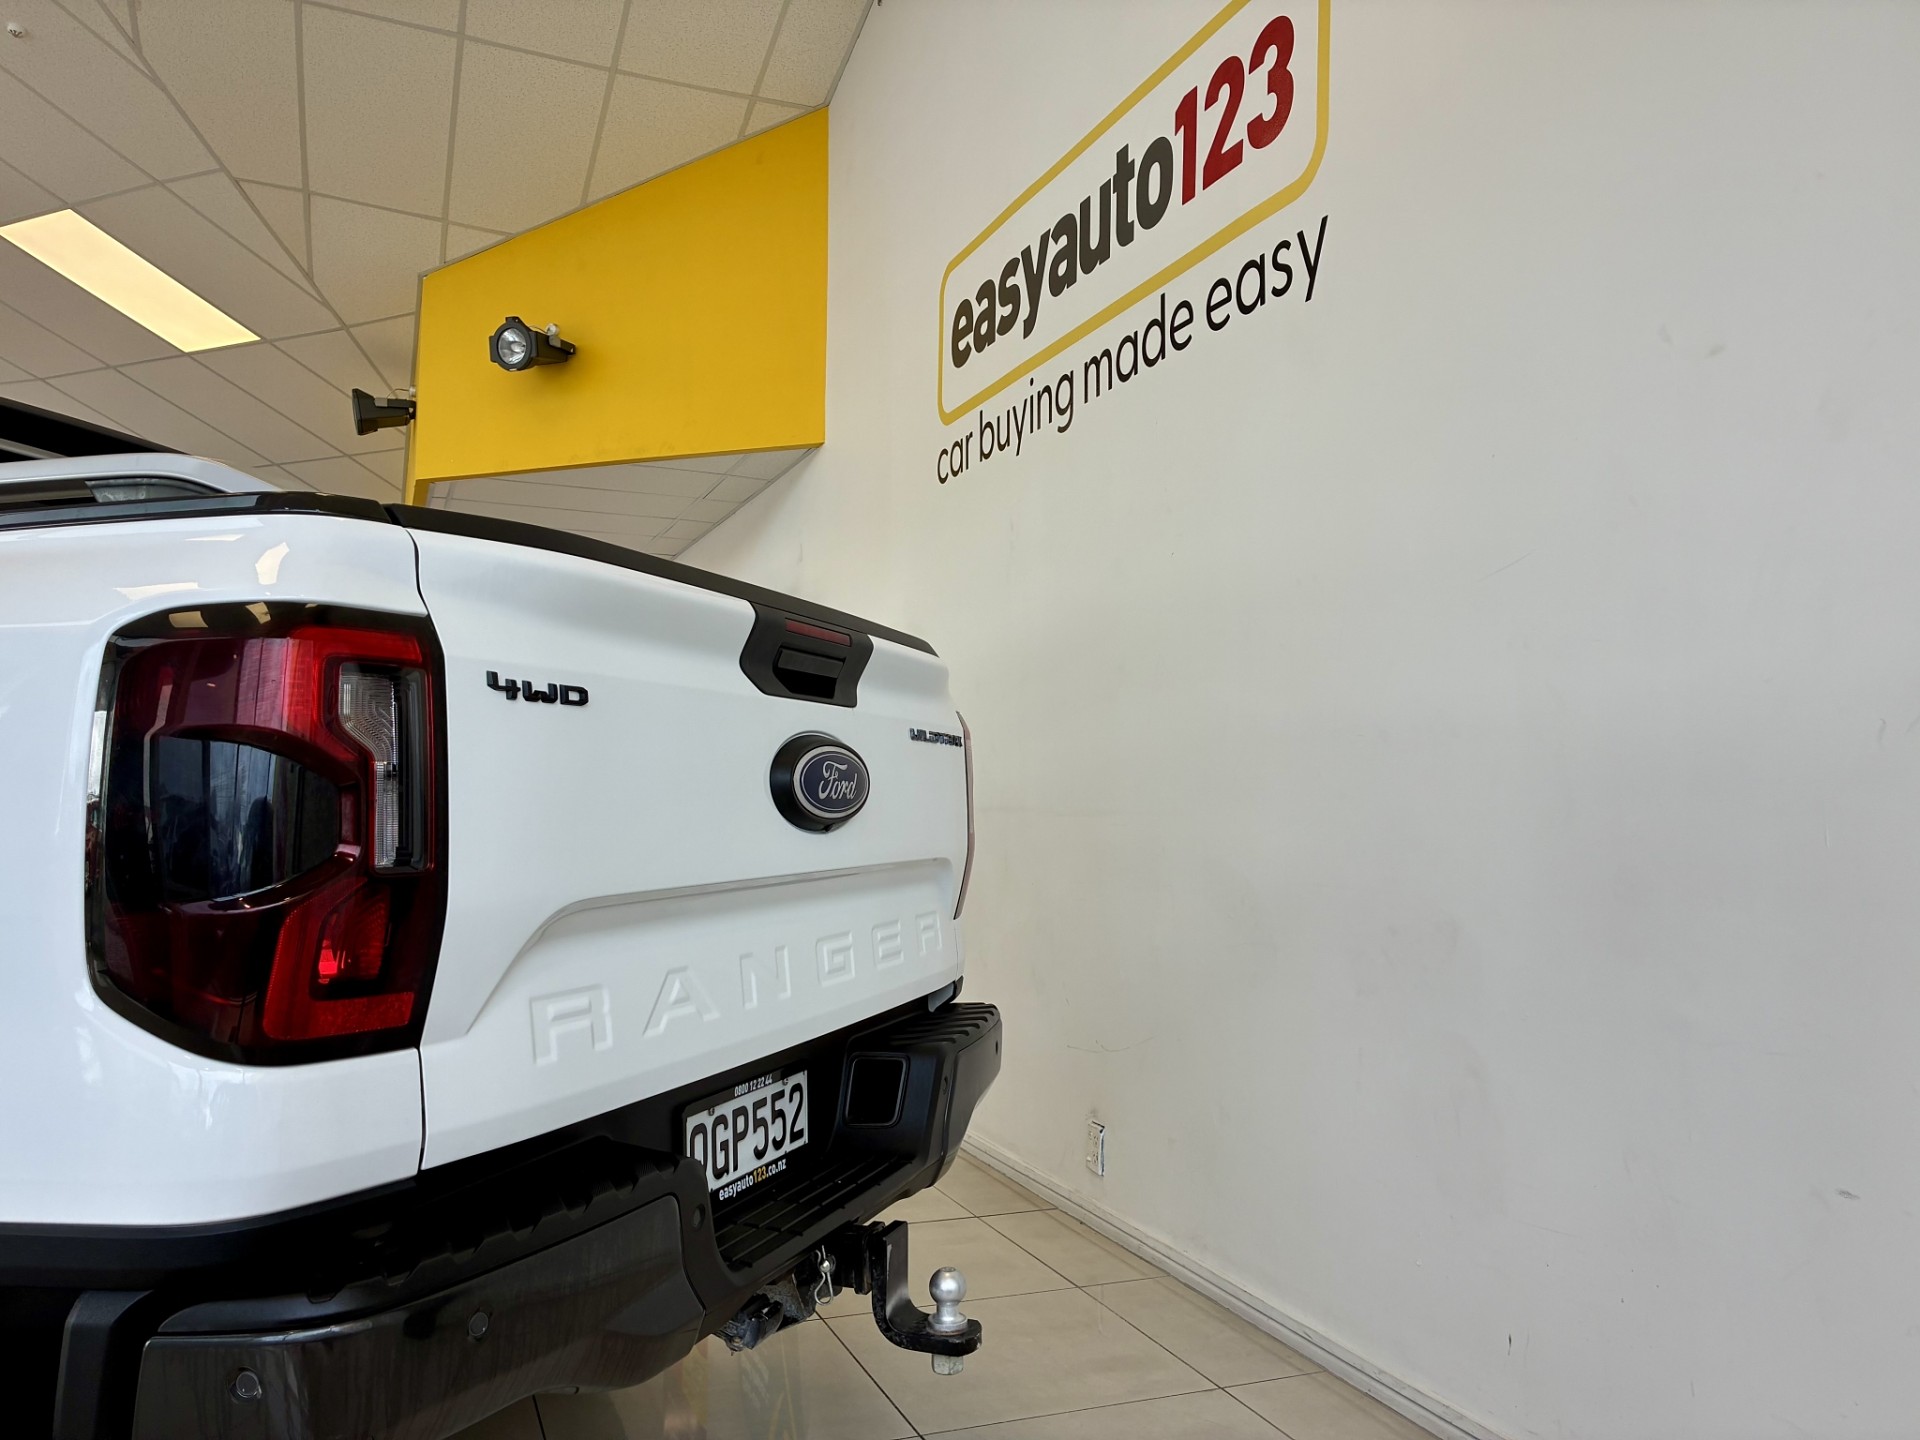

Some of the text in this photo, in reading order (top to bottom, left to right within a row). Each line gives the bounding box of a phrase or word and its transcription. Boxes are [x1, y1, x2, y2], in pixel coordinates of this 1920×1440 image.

[951, 15, 1295, 369] easyauto123
[937, 215, 1329, 484] car buying made easy
[486, 670, 589, 706] 4WD
[818, 760, 858, 800] Ford
[529, 910, 943, 1066] RANGER
[734, 1082, 749, 1098] 0800
[750, 1079, 757, 1091] 12
[719, 1158, 787, 1201] easyauto123.co.nz
